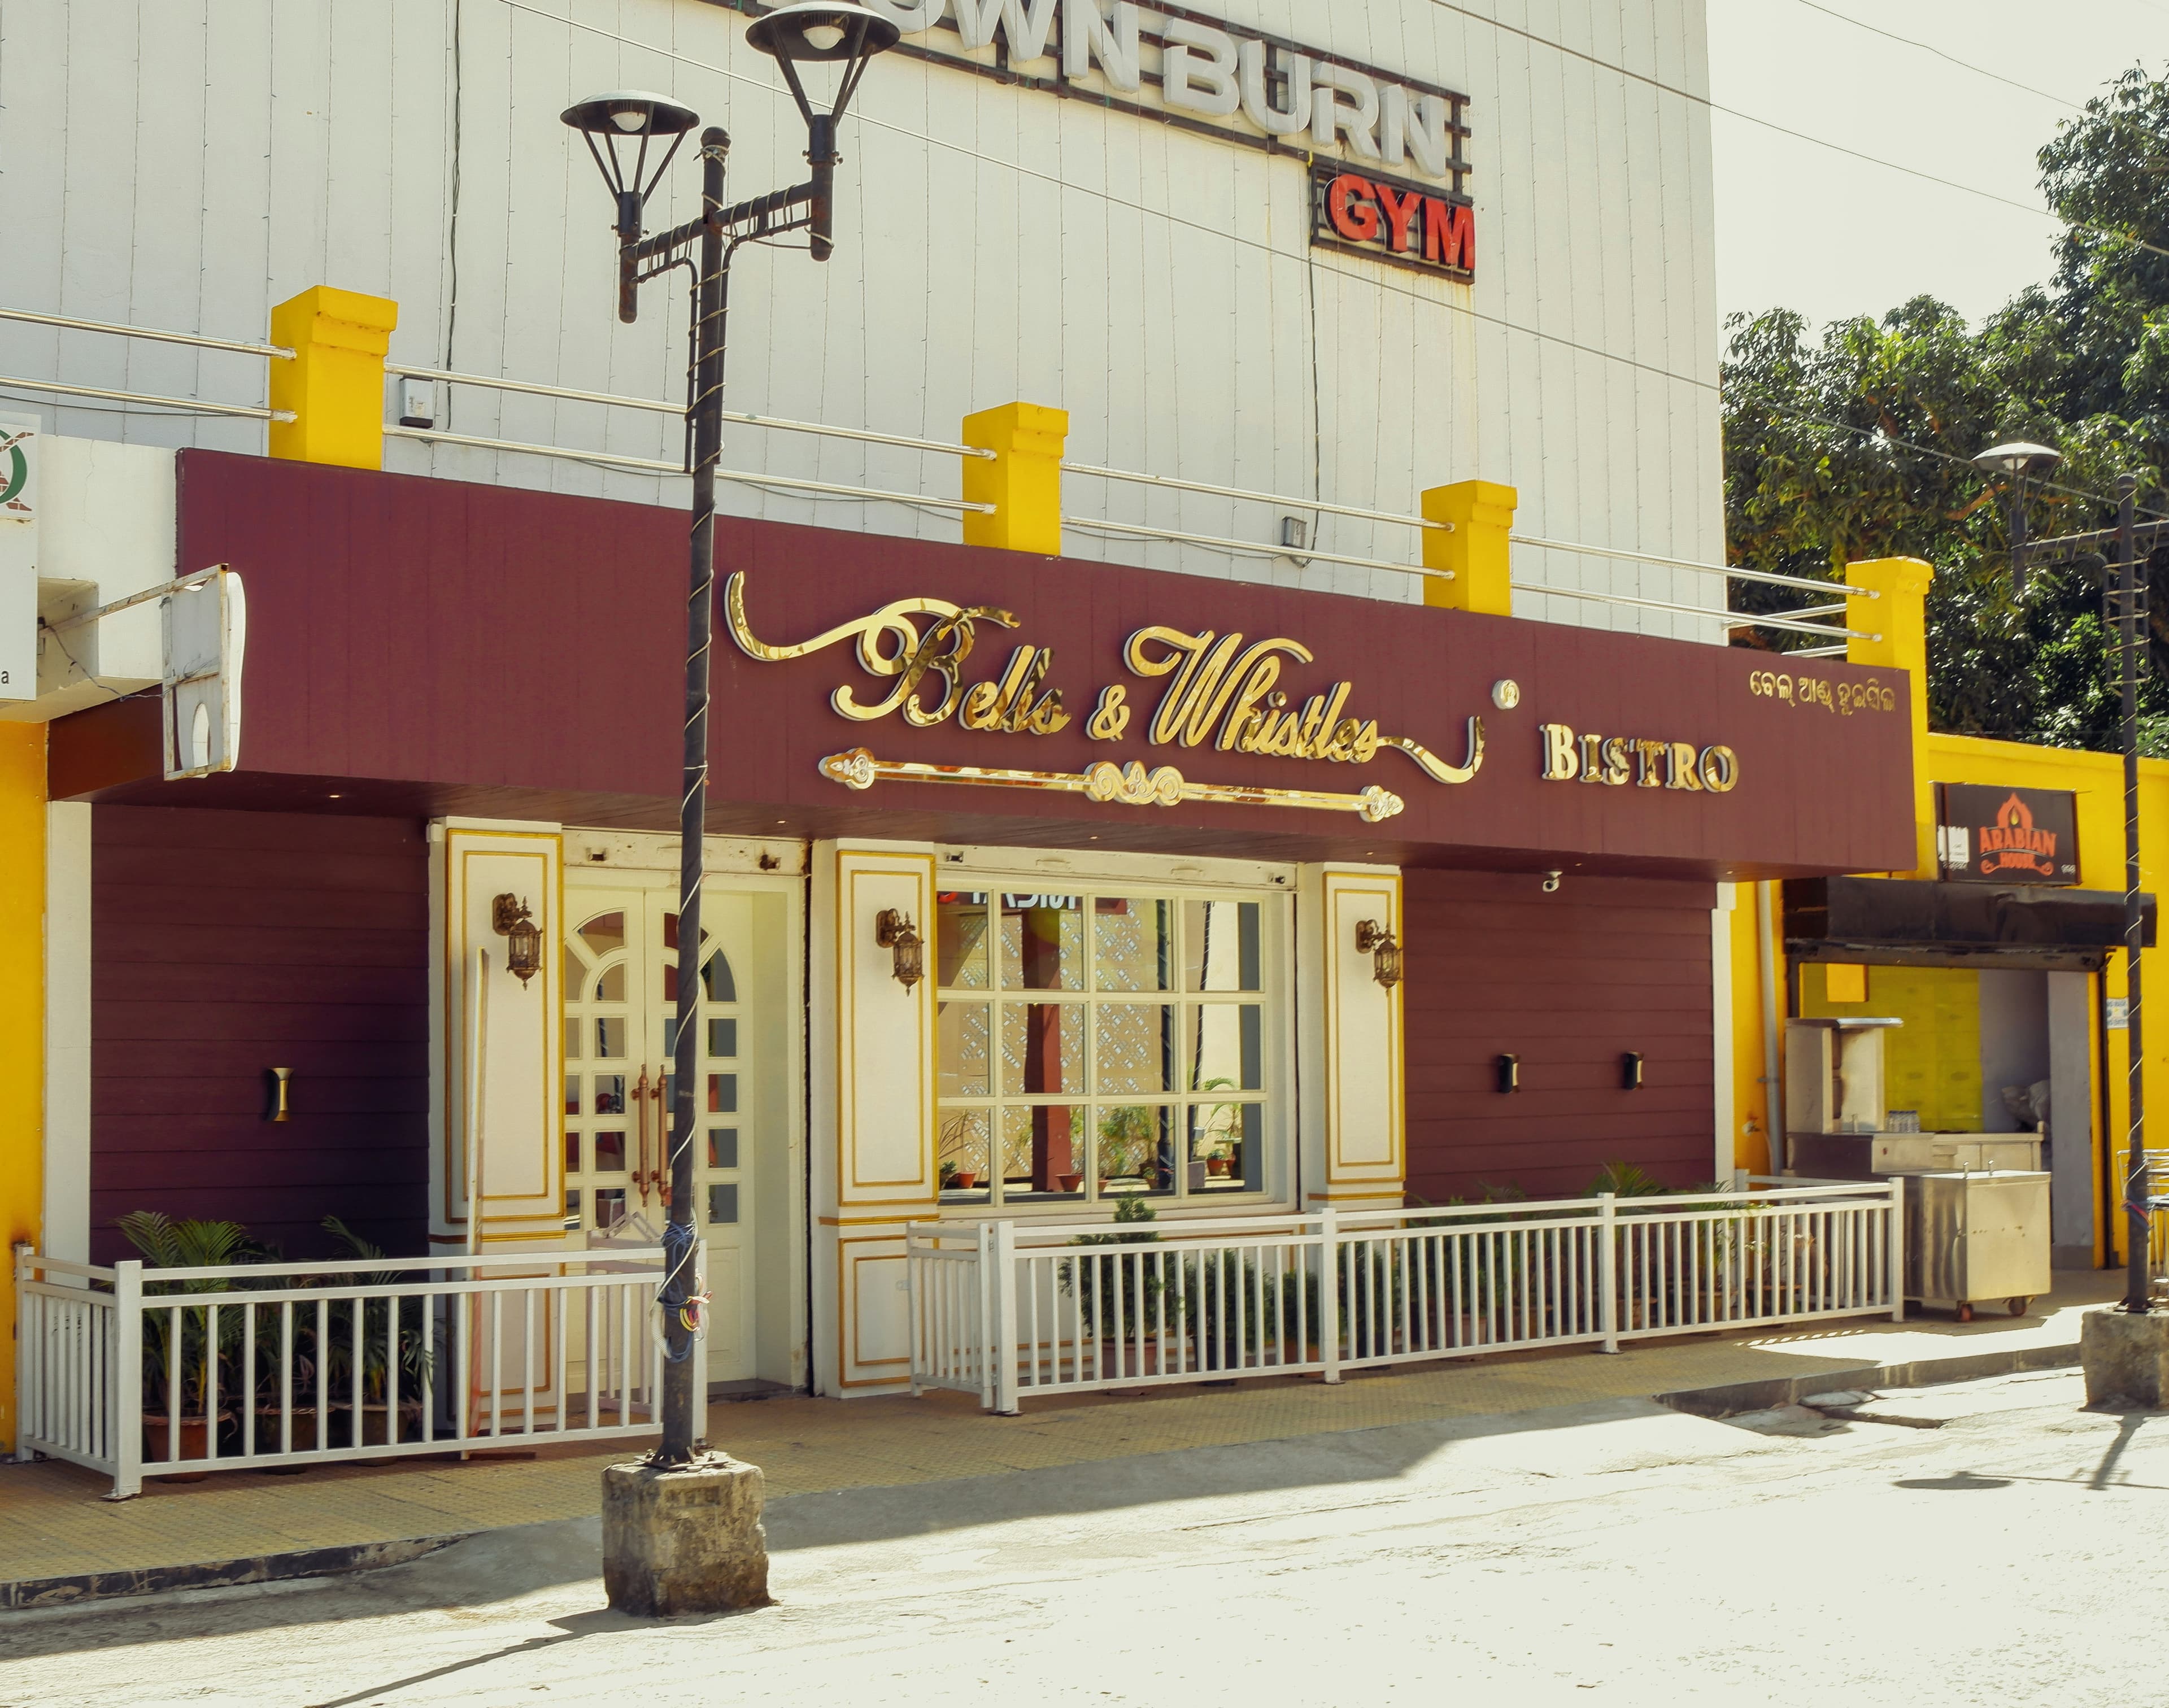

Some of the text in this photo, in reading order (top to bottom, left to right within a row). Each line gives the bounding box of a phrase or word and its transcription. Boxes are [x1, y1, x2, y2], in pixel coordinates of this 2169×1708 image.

[1163, 18, 1446, 178] BURN
[1322, 173, 1475, 270] GYM
[830, 596, 1378, 764] Bells & Whistles
[1539, 722, 1739, 793] BISTRO
[1979, 826, 2057, 857] ARABIAN
